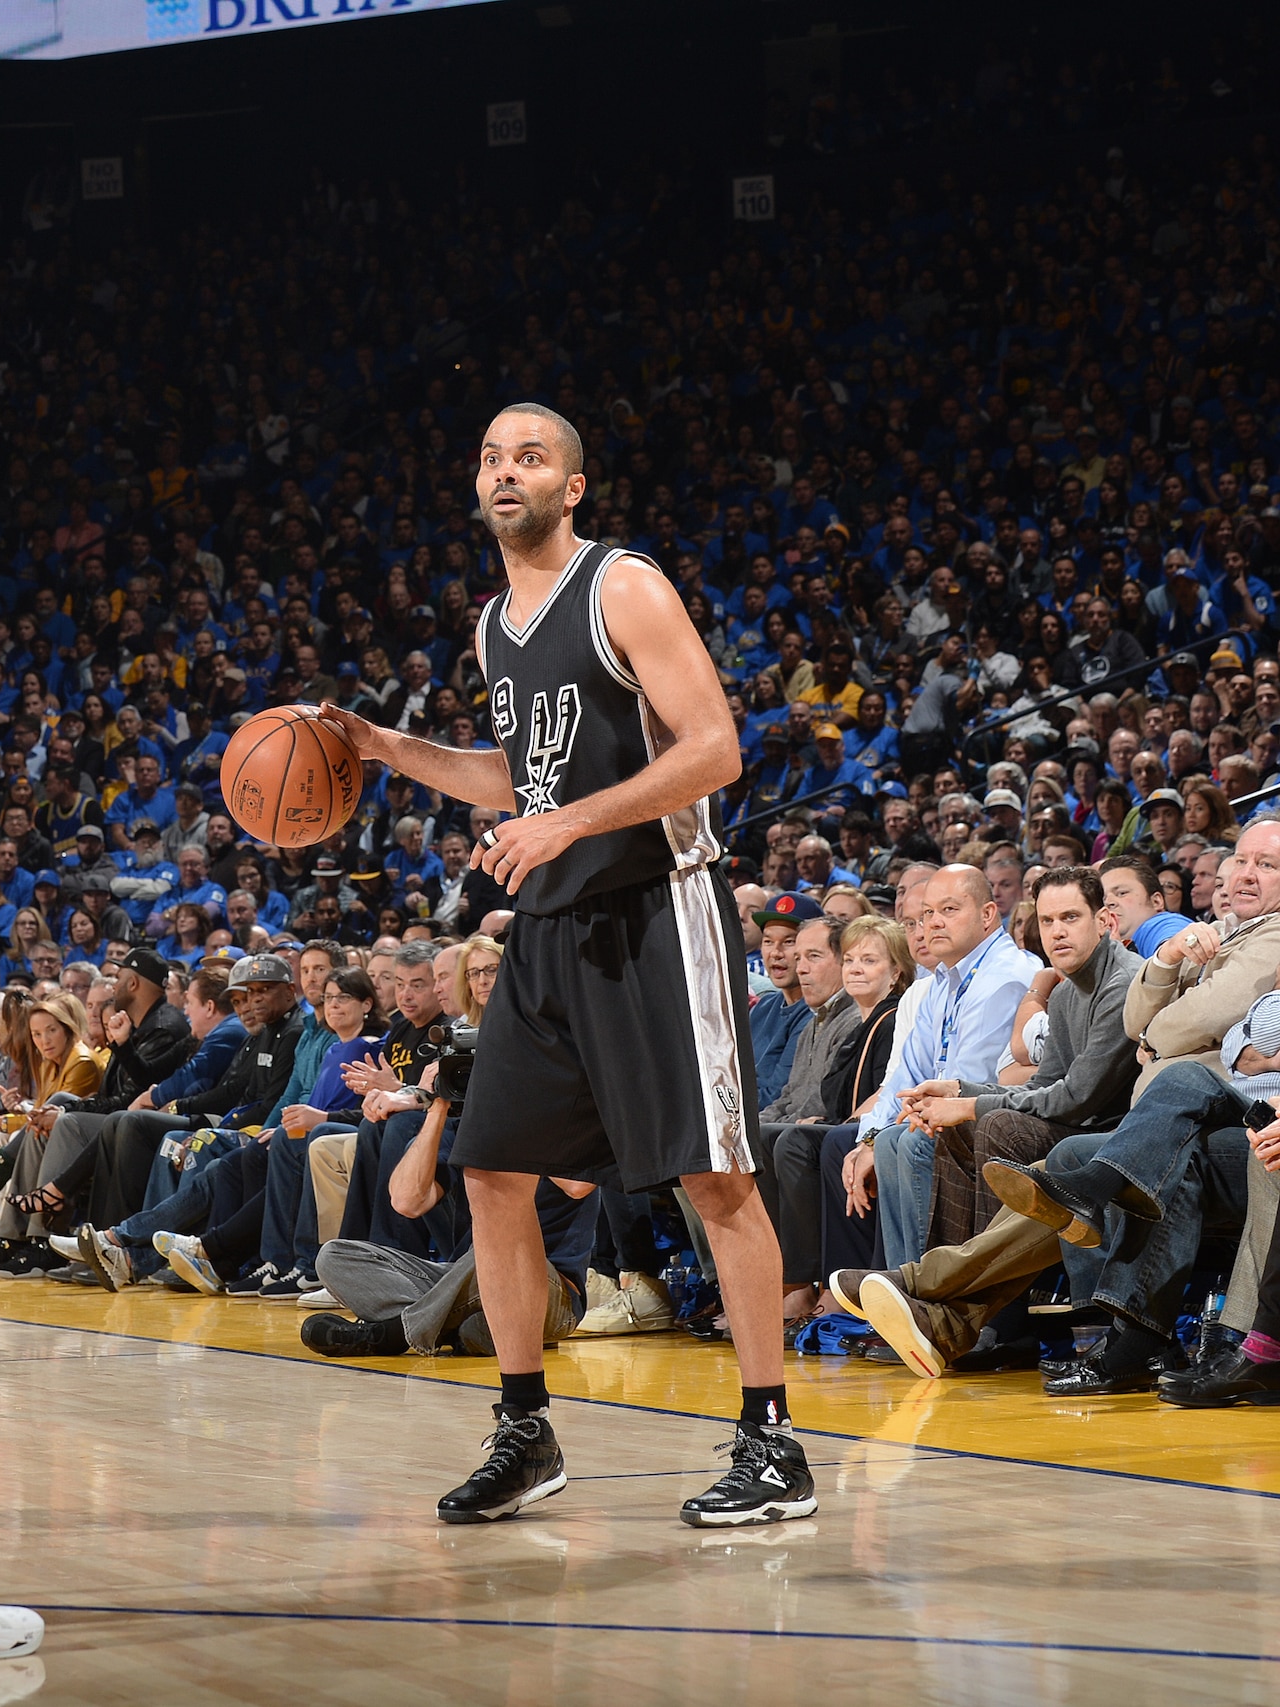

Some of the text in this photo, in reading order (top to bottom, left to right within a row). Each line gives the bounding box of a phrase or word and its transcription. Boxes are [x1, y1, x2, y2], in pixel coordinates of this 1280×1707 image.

[490, 119, 524, 141] 109
[89, 163, 115, 177] NO
[85, 178, 120, 195] EXIT
[741, 180, 766, 194] SEC
[737, 195, 771, 218] 110
[491, 676, 518, 741] 9
